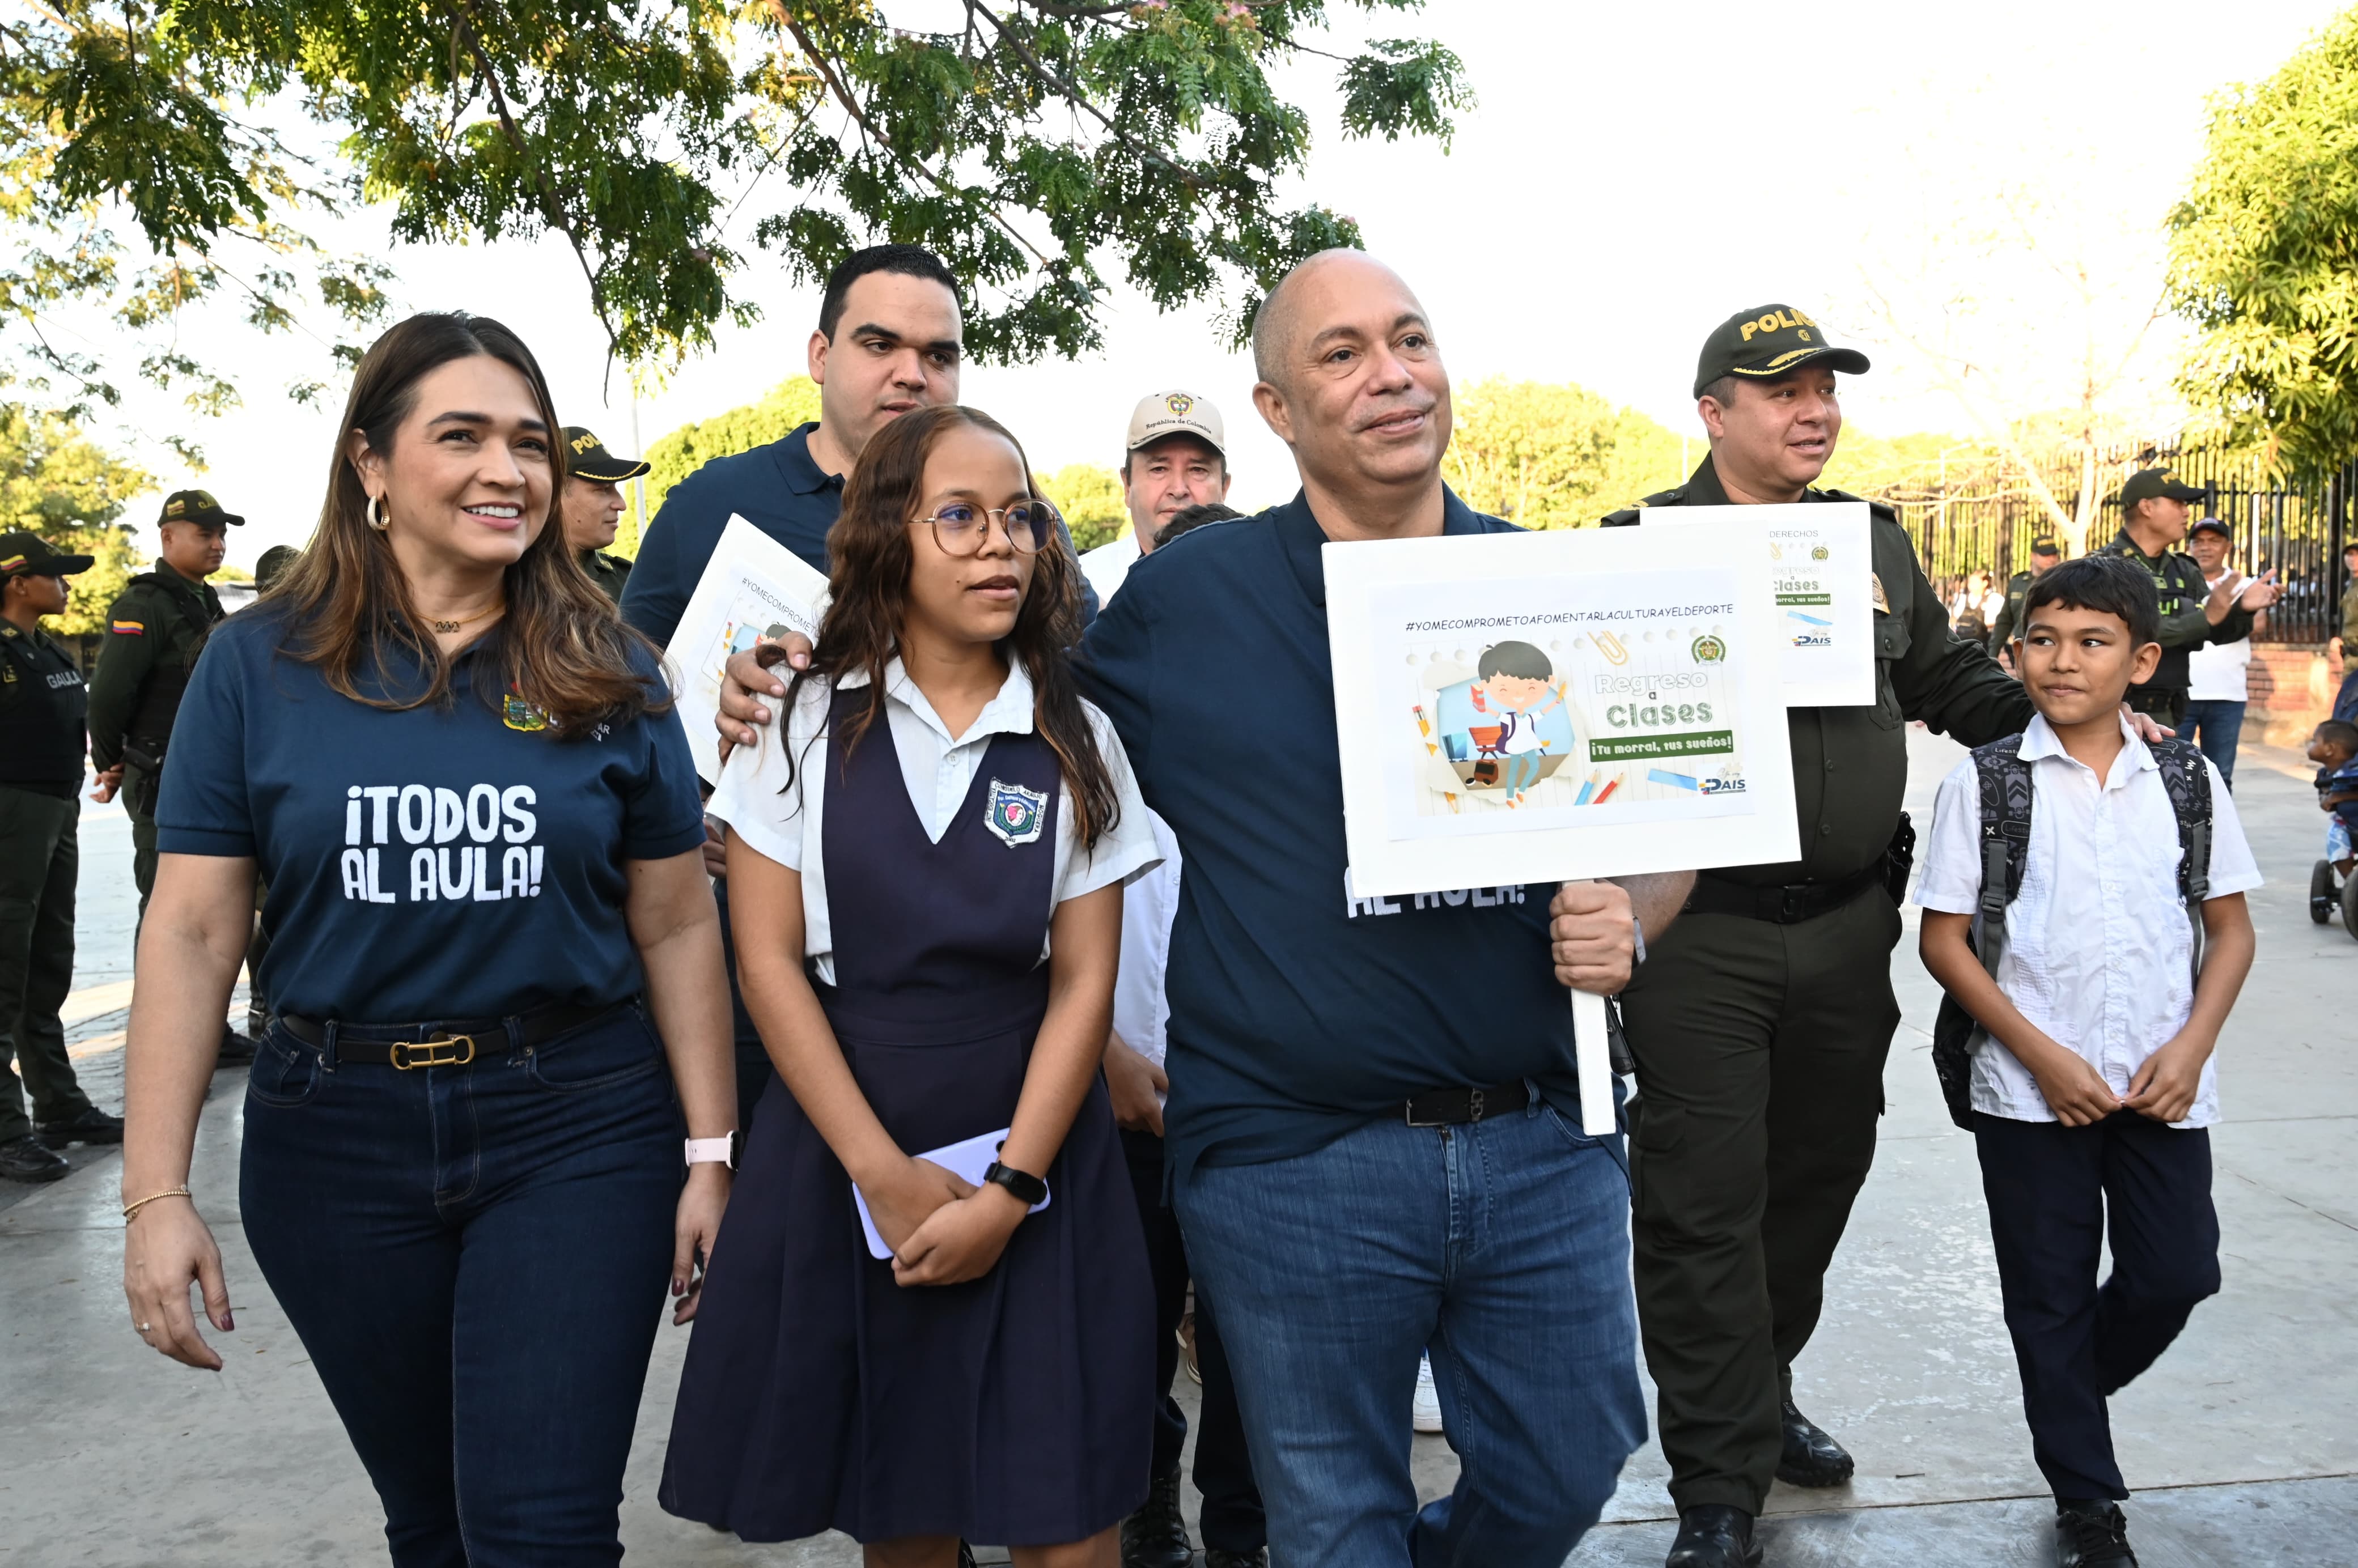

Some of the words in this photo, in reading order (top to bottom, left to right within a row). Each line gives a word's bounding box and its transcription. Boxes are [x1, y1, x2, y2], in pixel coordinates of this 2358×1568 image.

[1740, 308, 1818, 342] POLIC
[1186, 419, 1212, 434] Colombia
[1772, 566, 1820, 577] egreso
[741, 576, 816, 634] #YOMECOMPROMET
[1405, 604, 1734, 631] #YOMECOMPROMETOAFOMENTARLACULTURAYELDEPORTE
[45, 670, 83, 689] GAULA
[1594, 673, 1708, 696] Regreso
[1648, 691, 1657, 700] a
[1606, 702, 1713, 728] Clases
[1592, 742, 1611, 756] ¡Tu
[1615, 741, 1661, 754] morral,
[1664, 741, 1683, 750] tus
[1686, 736, 1732, 749] sueños!
[345, 783, 537, 845] ¡TODOS
[341, 847, 396, 904] AL
[410, 845, 544, 902] AULA!
